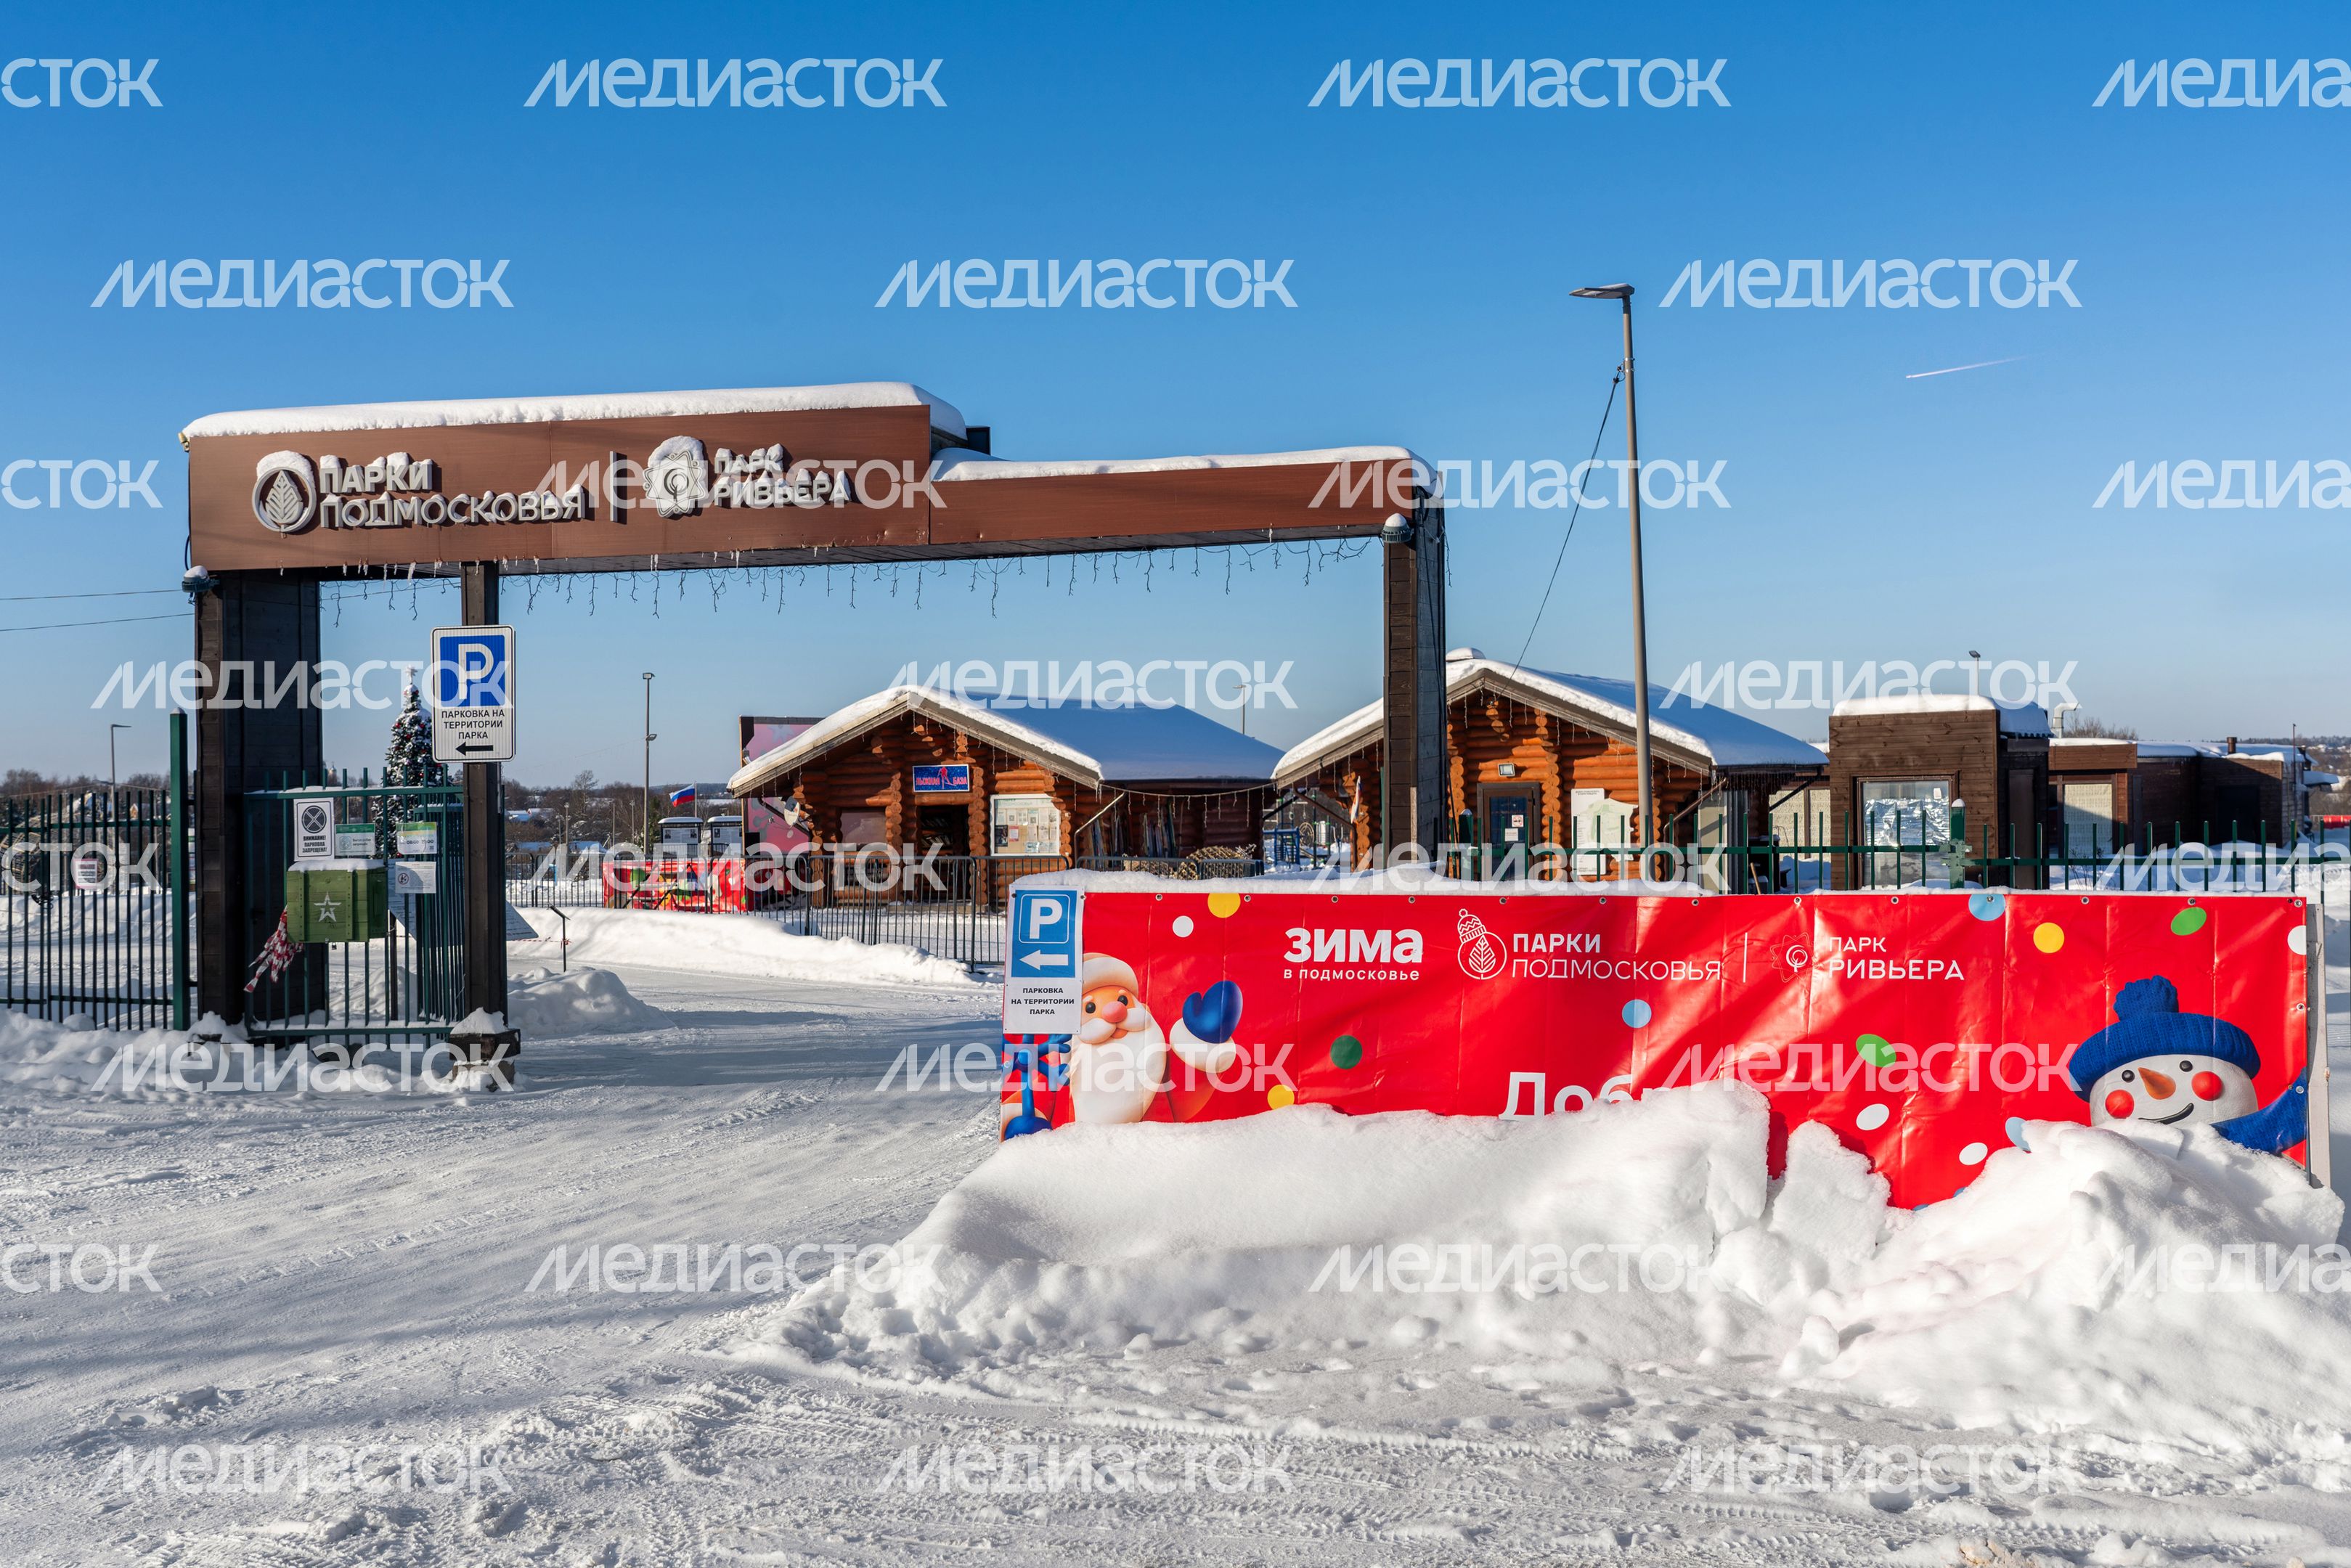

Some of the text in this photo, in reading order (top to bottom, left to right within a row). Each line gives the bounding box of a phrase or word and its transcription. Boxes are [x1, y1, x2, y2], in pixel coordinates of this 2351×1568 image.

[714, 455, 783, 474] ПАРК
[320, 463, 433, 494] ПАРКИ
[714, 479, 852, 506] РИВЬЕРА
[320, 492, 585, 528] ПОДМОСКОВЬЯ
[458, 643, 494, 700] P
[441, 710, 490, 719] ПАРКОВКА
[444, 720, 503, 729] ТЕРРИТОРИИ
[1029, 898, 1063, 939] P
[1513, 934, 1600, 953] ПАРКИ
[1829, 936, 1887, 952] ПАРК
[1284, 969, 1419, 981] в подмосковье
[1512, 959, 1722, 980] ПОДМОСКОВЬЯ
[1828, 959, 1965, 980] РИВЬЕРА
[1498, 1071, 1671, 1121] Доб
